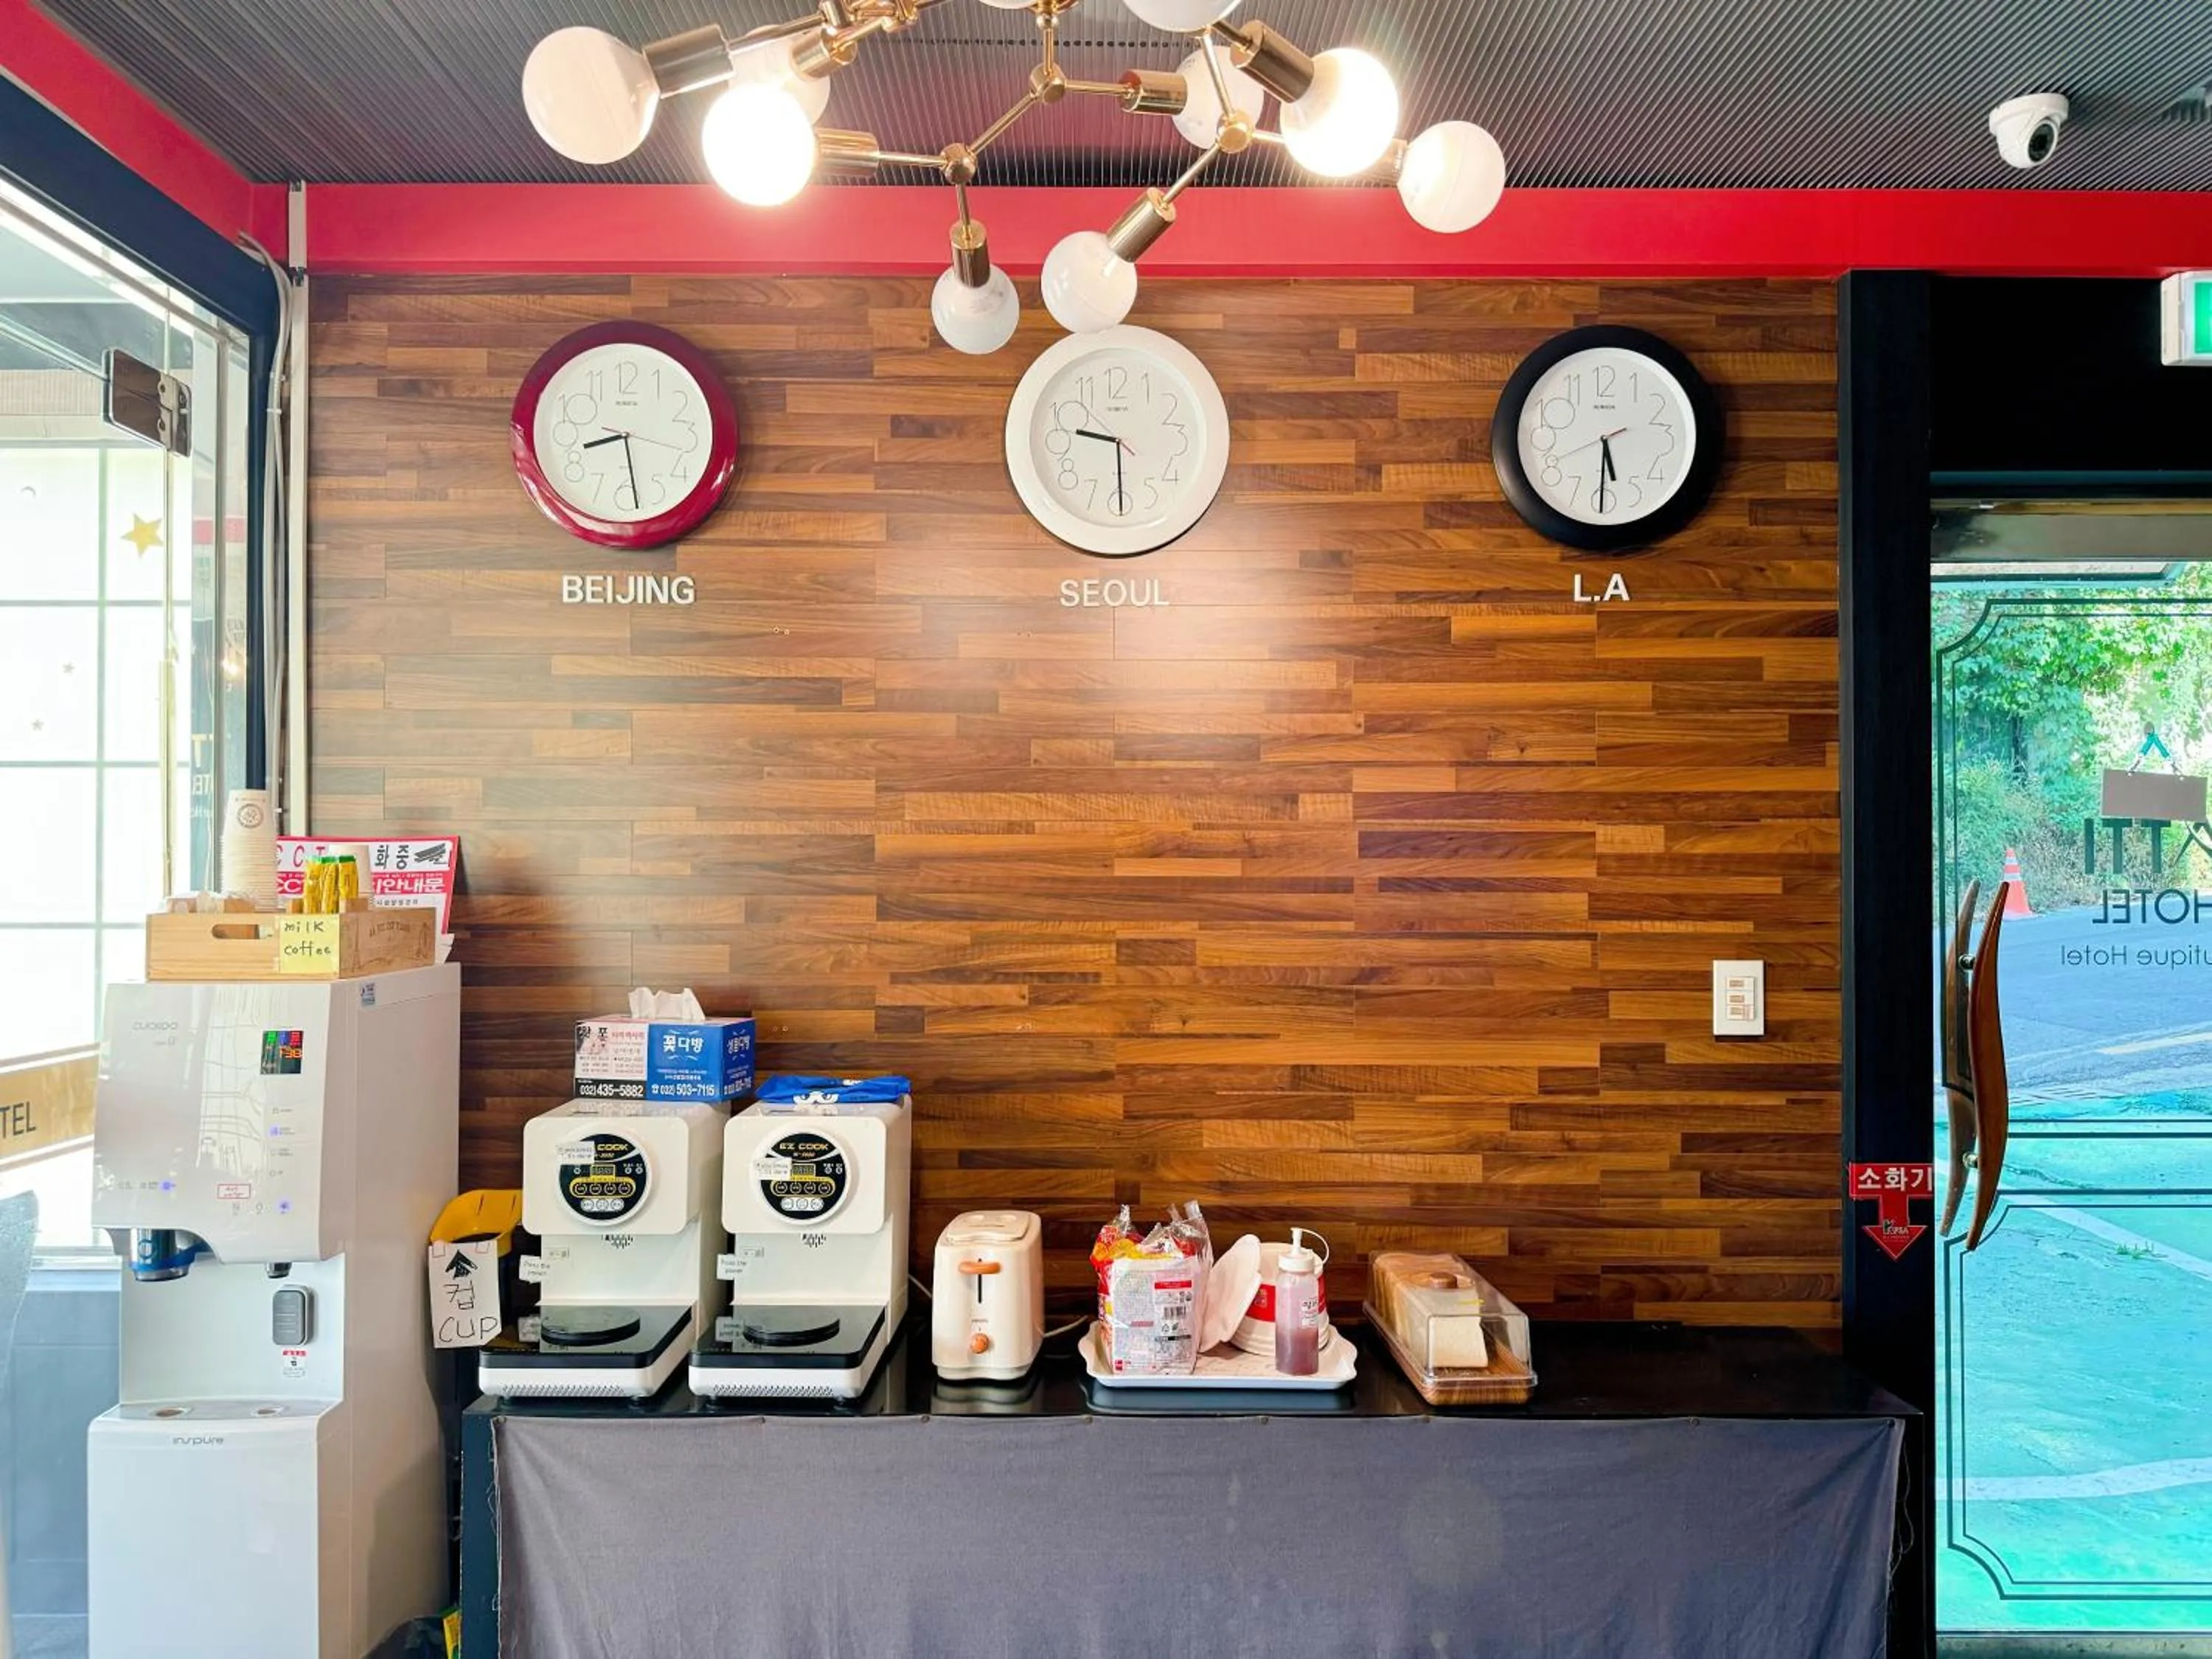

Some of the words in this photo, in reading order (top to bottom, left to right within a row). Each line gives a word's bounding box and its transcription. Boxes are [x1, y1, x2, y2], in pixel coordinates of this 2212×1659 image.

[585, 369, 603, 402] 11
[614, 361, 639, 394] 12
[650, 369, 661, 400] 1
[1074, 376, 1094, 408] 11
[1104, 366, 1129, 400] 12
[1141, 372, 1150, 404] 1
[1563, 373, 1581, 406] 11
[1593, 365, 1616, 397] 12
[1629, 372, 1638, 403] 1
[557, 392, 599, 425] 10
[672, 390, 689, 422] 2
[1049, 400, 1090, 431] 10
[1161, 393, 1178, 425] 2
[1535, 397, 1576, 430] 10
[1649, 393, 1666, 425] 2
[552, 420, 579, 451] 9
[685, 421, 699, 453] 3
[1045, 428, 1071, 461] 9
[1173, 424, 1189, 456] 3
[1530, 425, 1557, 458] 9
[1661, 424, 1675, 456] 3
[563, 451, 585, 483] 8
[669, 449, 690, 483] 4
[1057, 458, 1079, 490] 8
[1161, 455, 1180, 484] 4
[1540, 454, 1562, 487] 8
[1646, 454, 1664, 484] 4
[590, 473, 605, 504] 7
[651, 473, 667, 505] 5
[1084, 479, 1098, 511] 7
[1144, 477, 1158, 509] 5
[1568, 476, 1582, 508] 7
[1627, 476, 1643, 508] 5
[562, 574, 695, 605] BEIJING
[1059, 579, 1170, 608] SEOUL
[1573, 572, 1630, 603] L.A
[0, 1102, 36, 1139] TEL
[1857, 1166, 1933, 1192] 소화기
[439, 1315, 498, 1343] CUP
